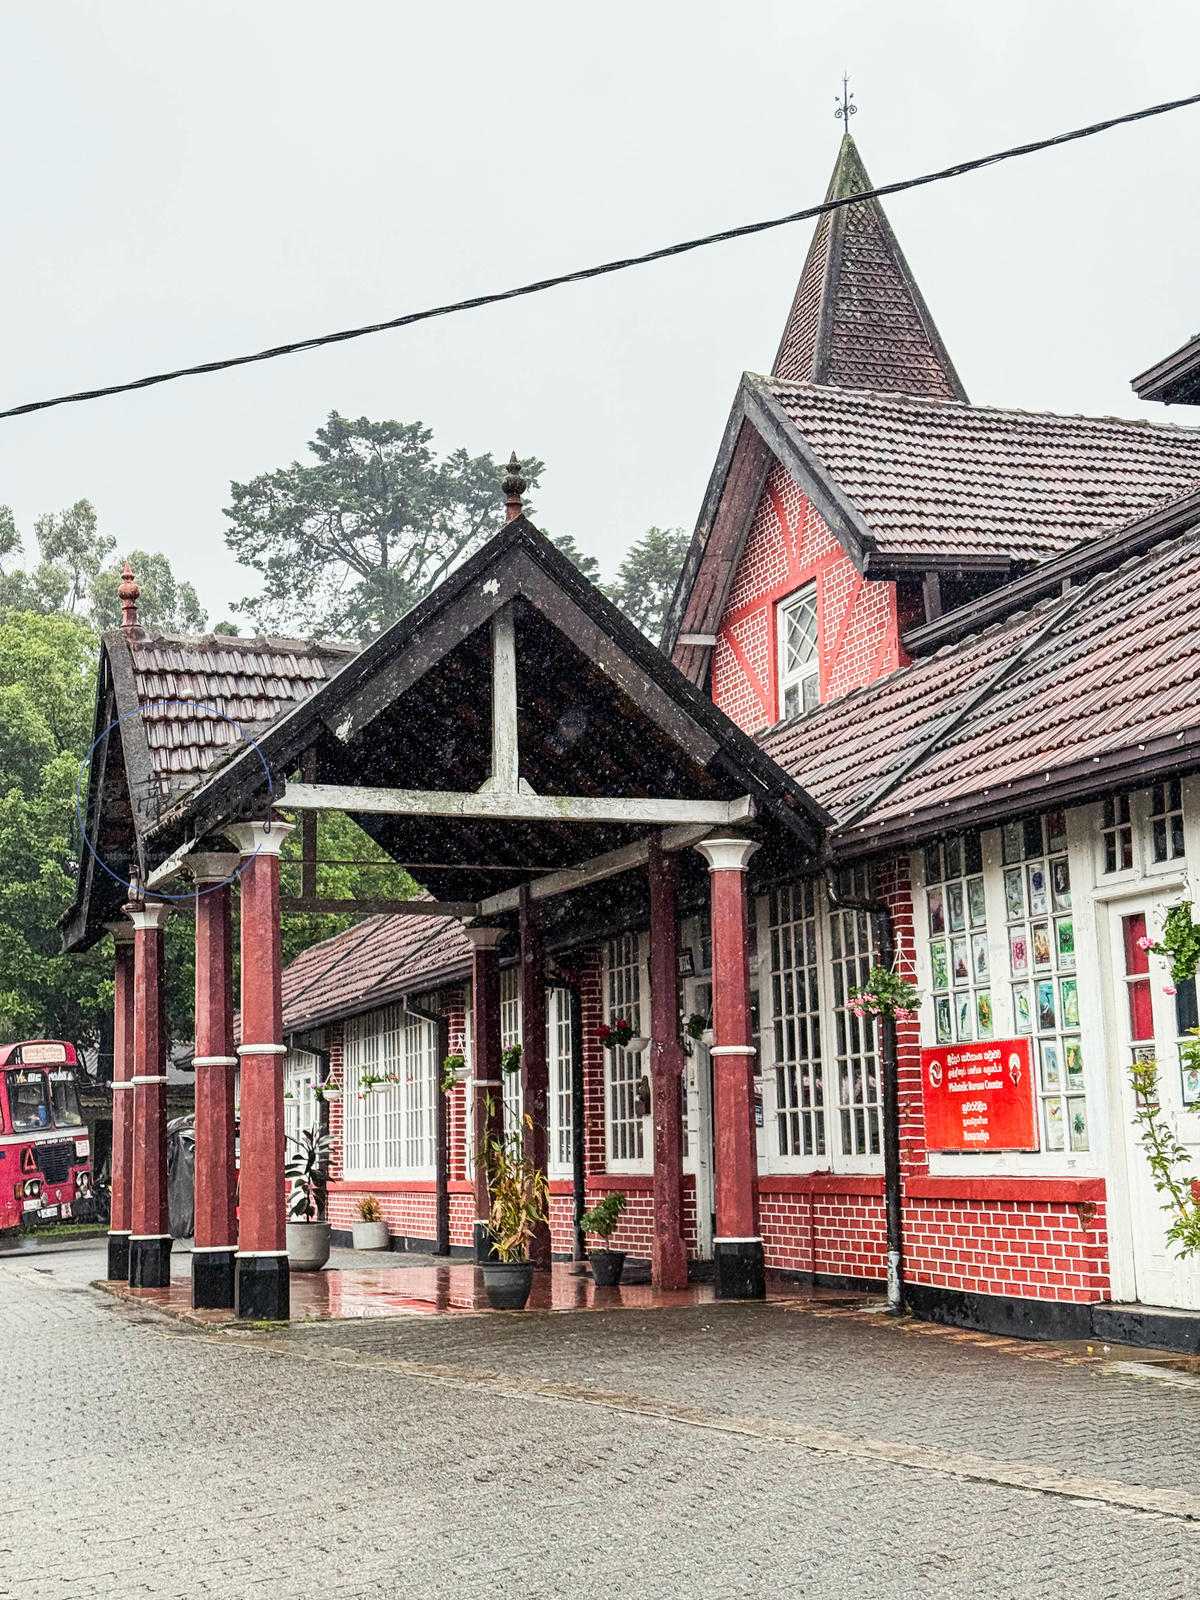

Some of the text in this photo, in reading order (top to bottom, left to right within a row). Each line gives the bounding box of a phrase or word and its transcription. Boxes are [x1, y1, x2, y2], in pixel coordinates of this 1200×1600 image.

[948, 1080, 1003, 1092] Philatelic Bureau Counter
